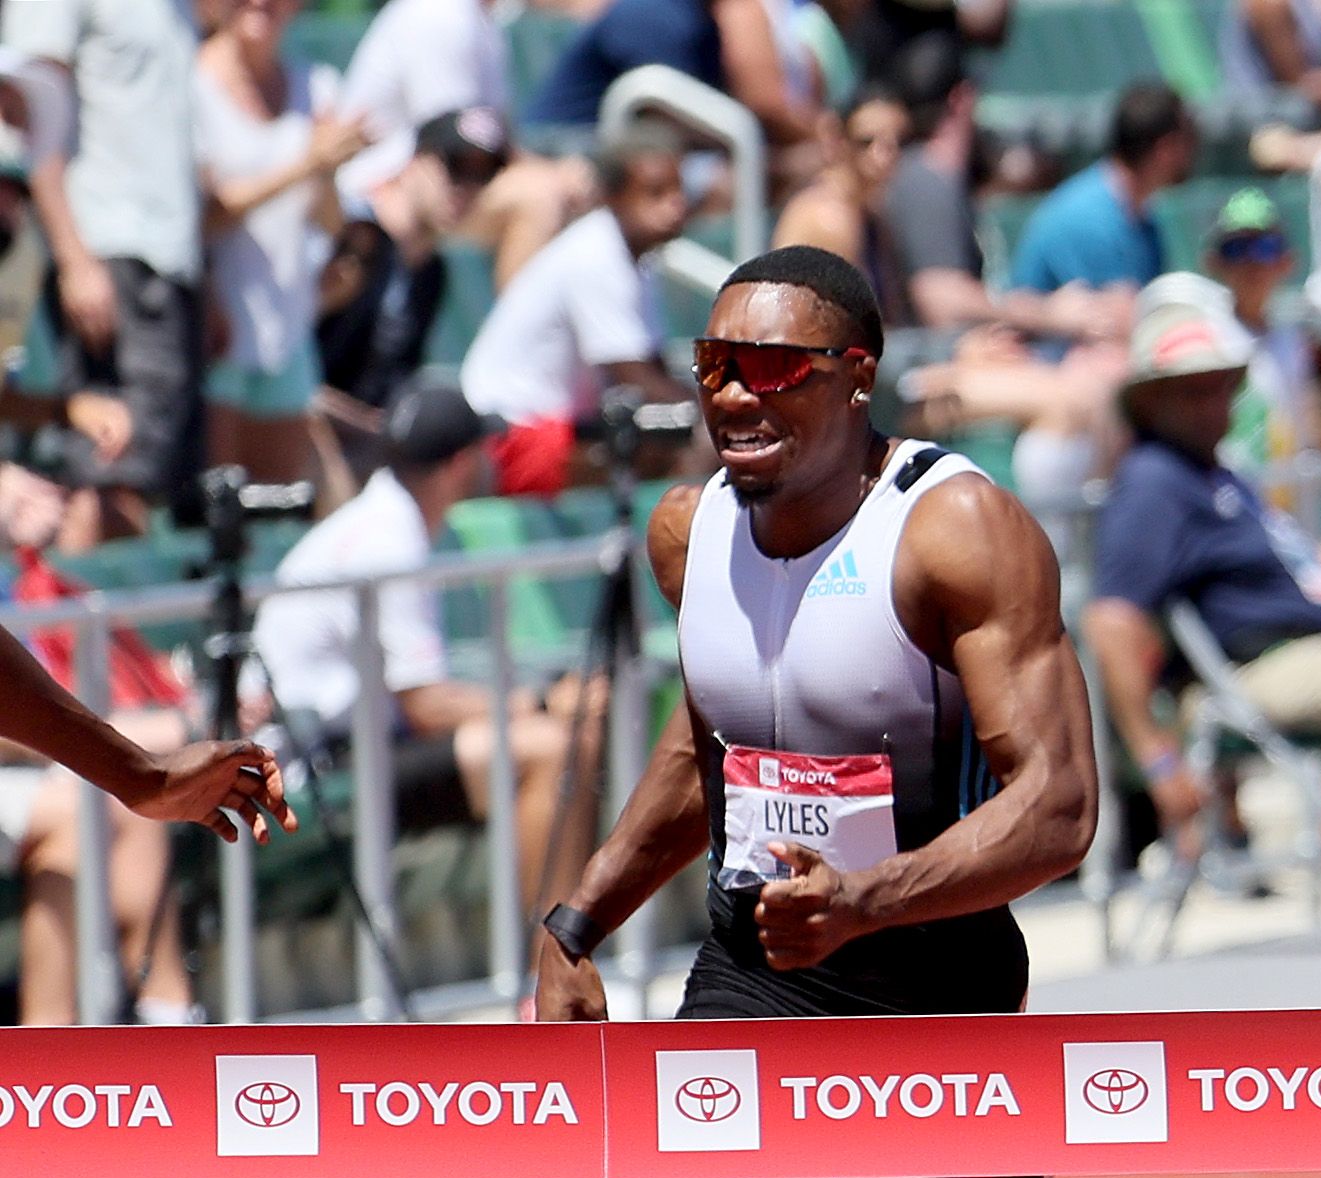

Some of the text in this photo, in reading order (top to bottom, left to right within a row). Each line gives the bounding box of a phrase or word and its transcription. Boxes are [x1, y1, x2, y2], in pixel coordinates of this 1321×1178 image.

[806, 579, 866, 598] adidas
[781, 768, 837, 785] TOYOTA
[765, 800, 829, 836] LYLES
[340, 1082, 579, 1126] TOYOTA
[781, 1074, 1021, 1120] TOYOTA
